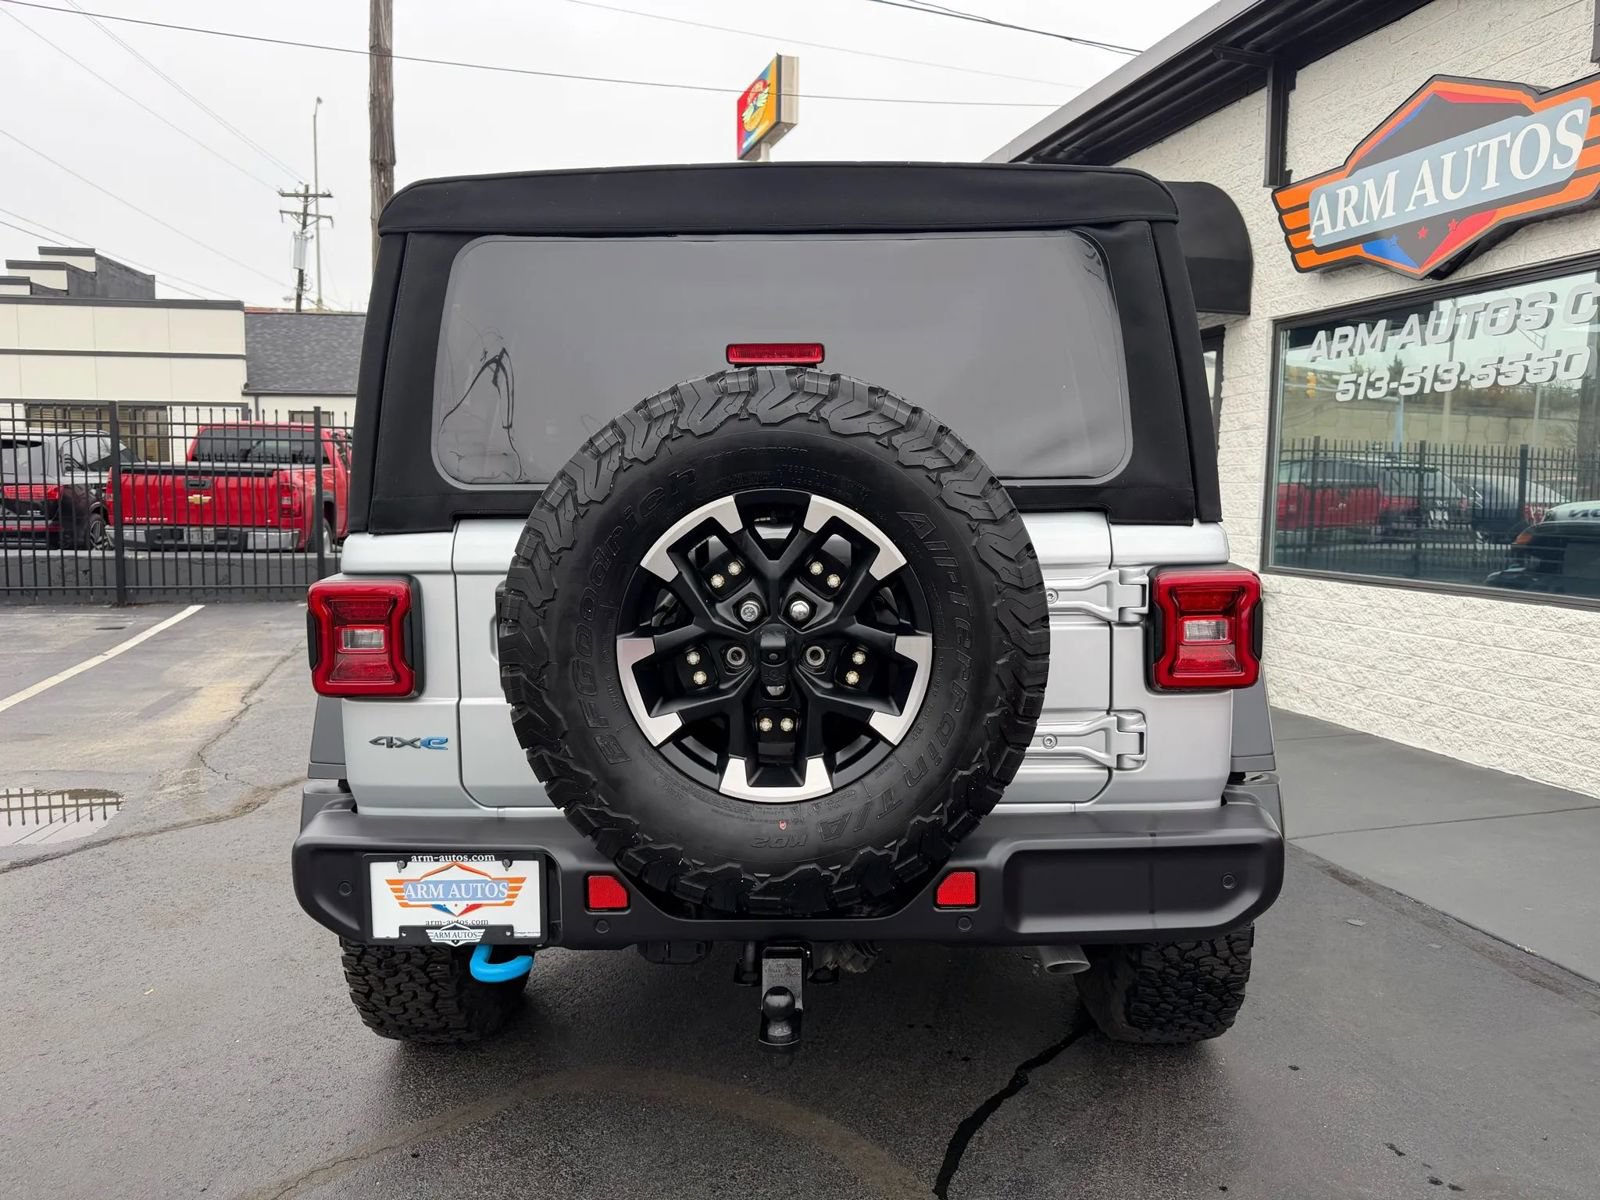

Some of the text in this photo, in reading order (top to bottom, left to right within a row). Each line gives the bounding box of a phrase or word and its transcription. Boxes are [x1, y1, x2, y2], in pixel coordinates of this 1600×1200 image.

[1306, 108, 1584, 240] ARM AUTOS
[1307, 319, 1388, 362] ARM
[1399, 290, 1554, 348] AUTOS
[1335, 345, 1590, 402] 513-513-5550
[411, 853, 496, 863] arm-autos.com
[404, 881, 509, 899] ARM AUTOS
[433, 930, 478, 939] ARM AUTOS
